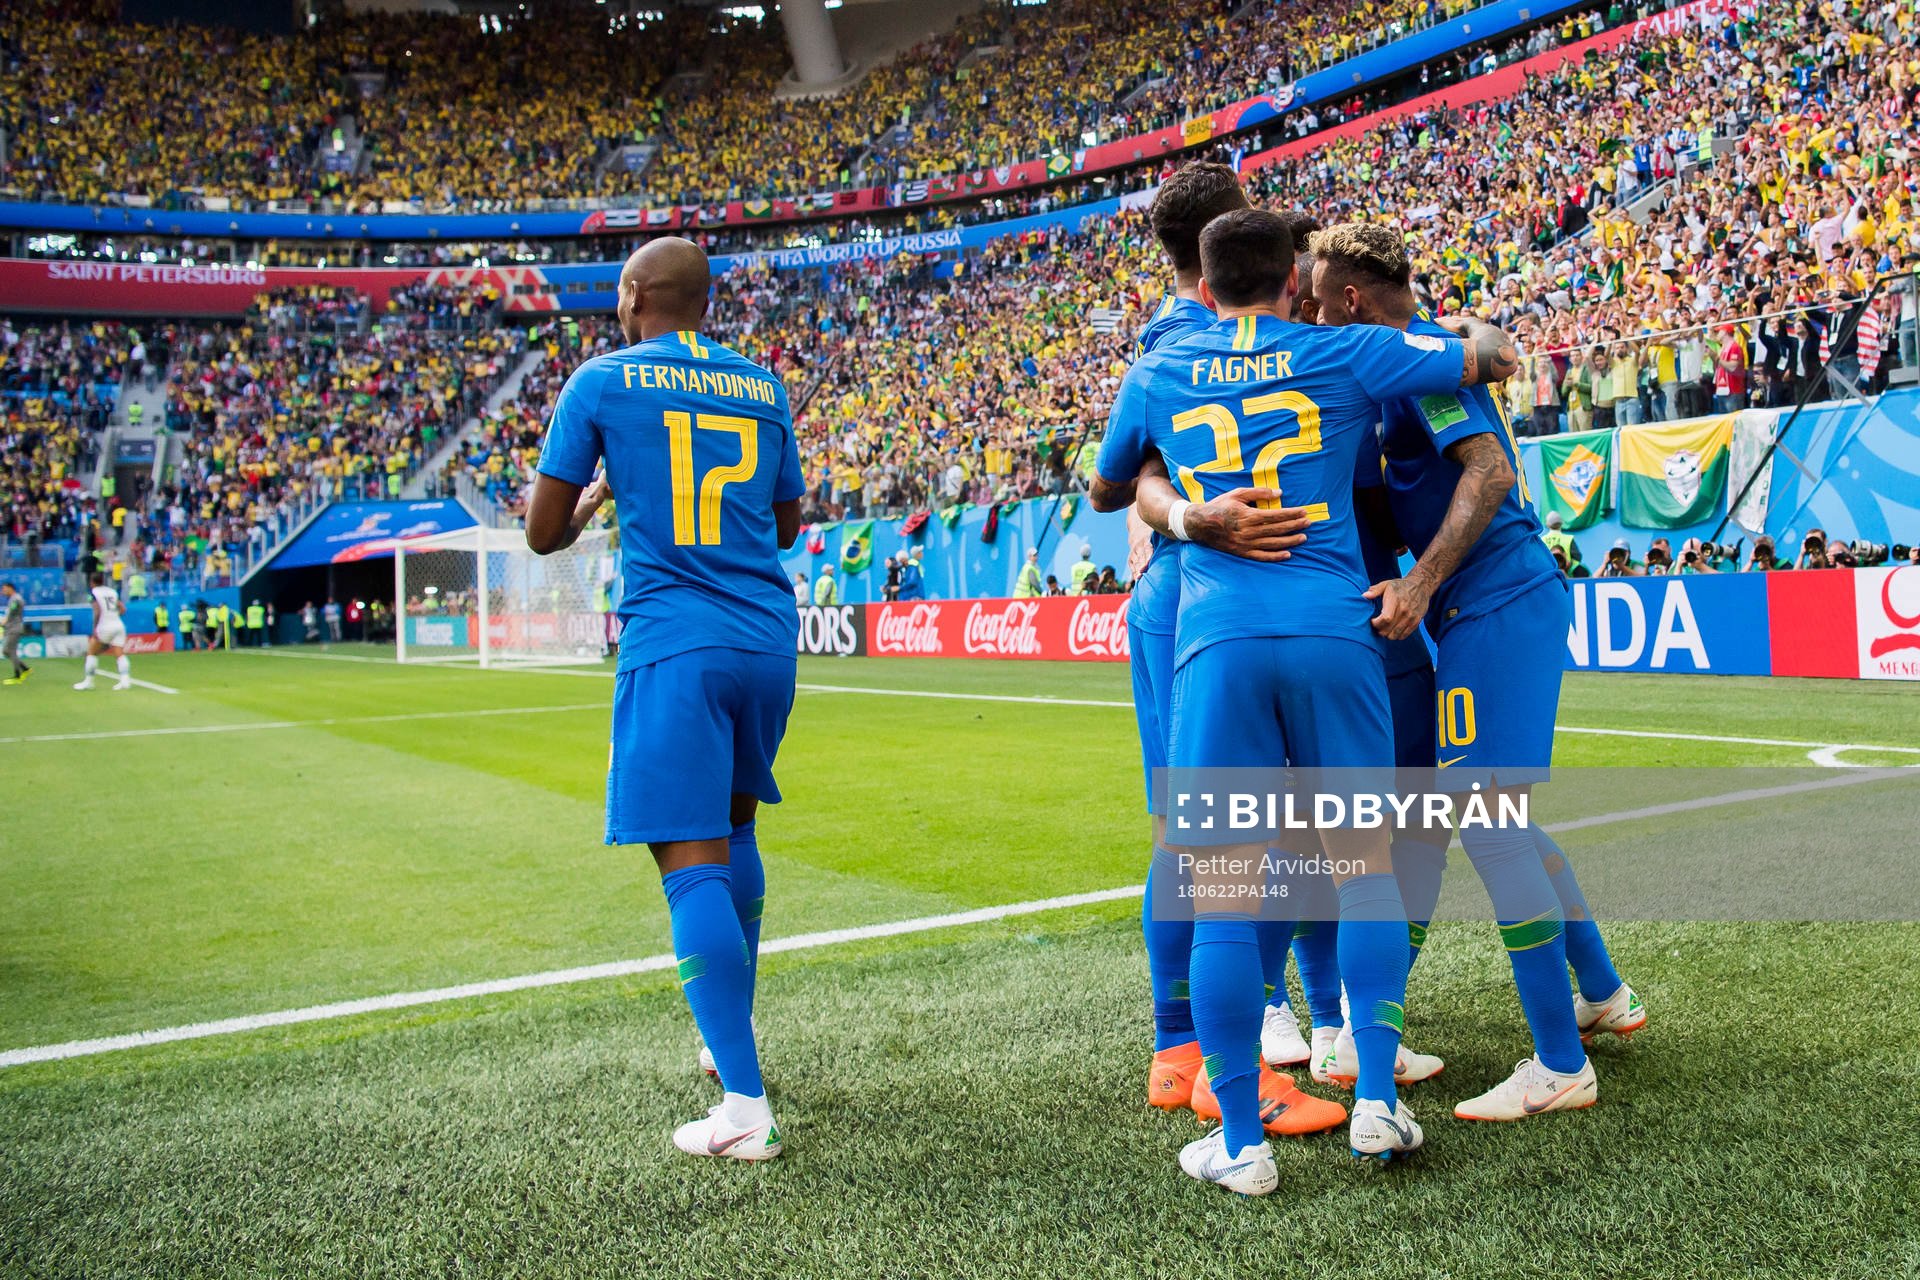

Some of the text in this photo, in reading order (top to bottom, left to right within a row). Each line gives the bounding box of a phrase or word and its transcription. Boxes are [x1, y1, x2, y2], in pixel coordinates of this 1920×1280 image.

[807, 242, 864, 263] WORLD
[866, 237, 901, 256] CUP
[903, 231, 962, 251] RUSSIA
[47, 262, 266, 285] SAINT PETERSBURG
[623, 364, 775, 405] FERNANDINHO
[1192, 351, 1294, 386] FAGNER
[1172, 390, 1331, 523] 22
[663, 410, 758, 545] 17
[1437, 687, 1477, 748] 10
